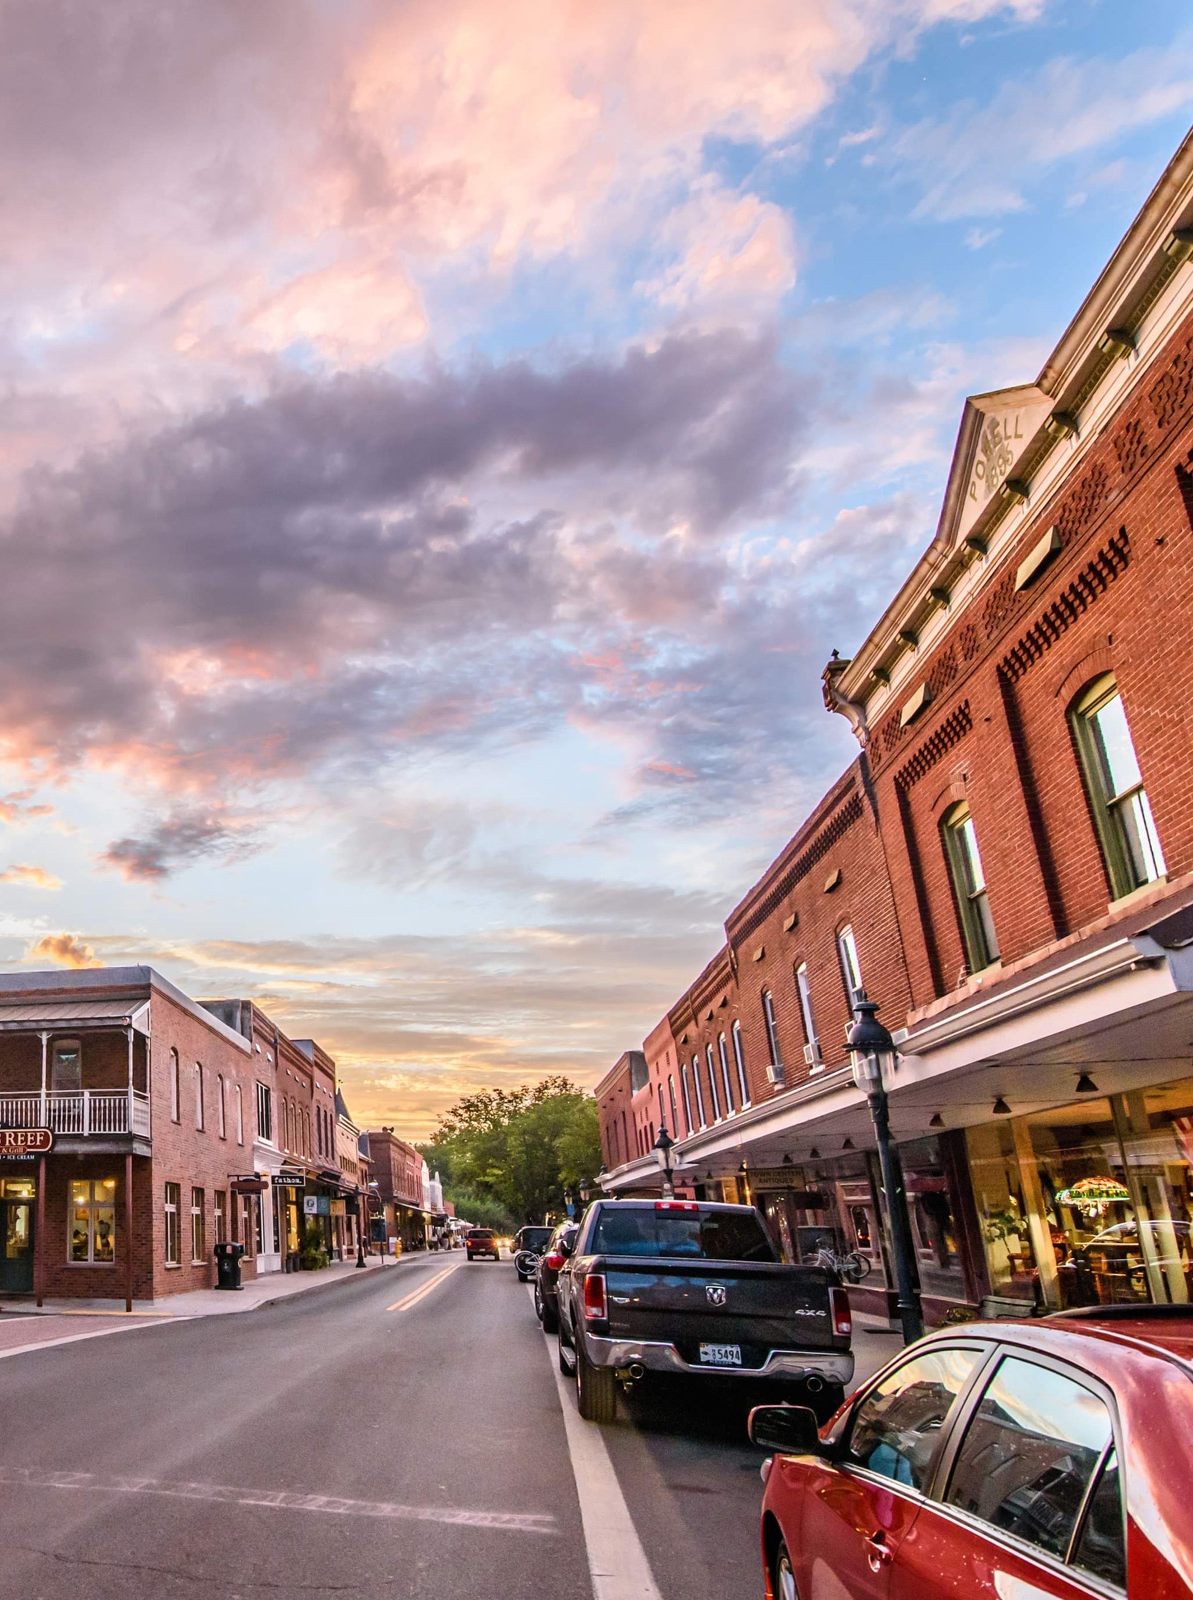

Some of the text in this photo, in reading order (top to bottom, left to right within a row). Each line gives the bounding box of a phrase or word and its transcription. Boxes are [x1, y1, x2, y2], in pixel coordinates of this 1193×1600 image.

[969, 415, 1023, 502] POWELL
[4, 1131, 45, 1146] REEF
[773, 1170, 802, 1178] CENTER
[717, 1349, 741, 1361] 5494
